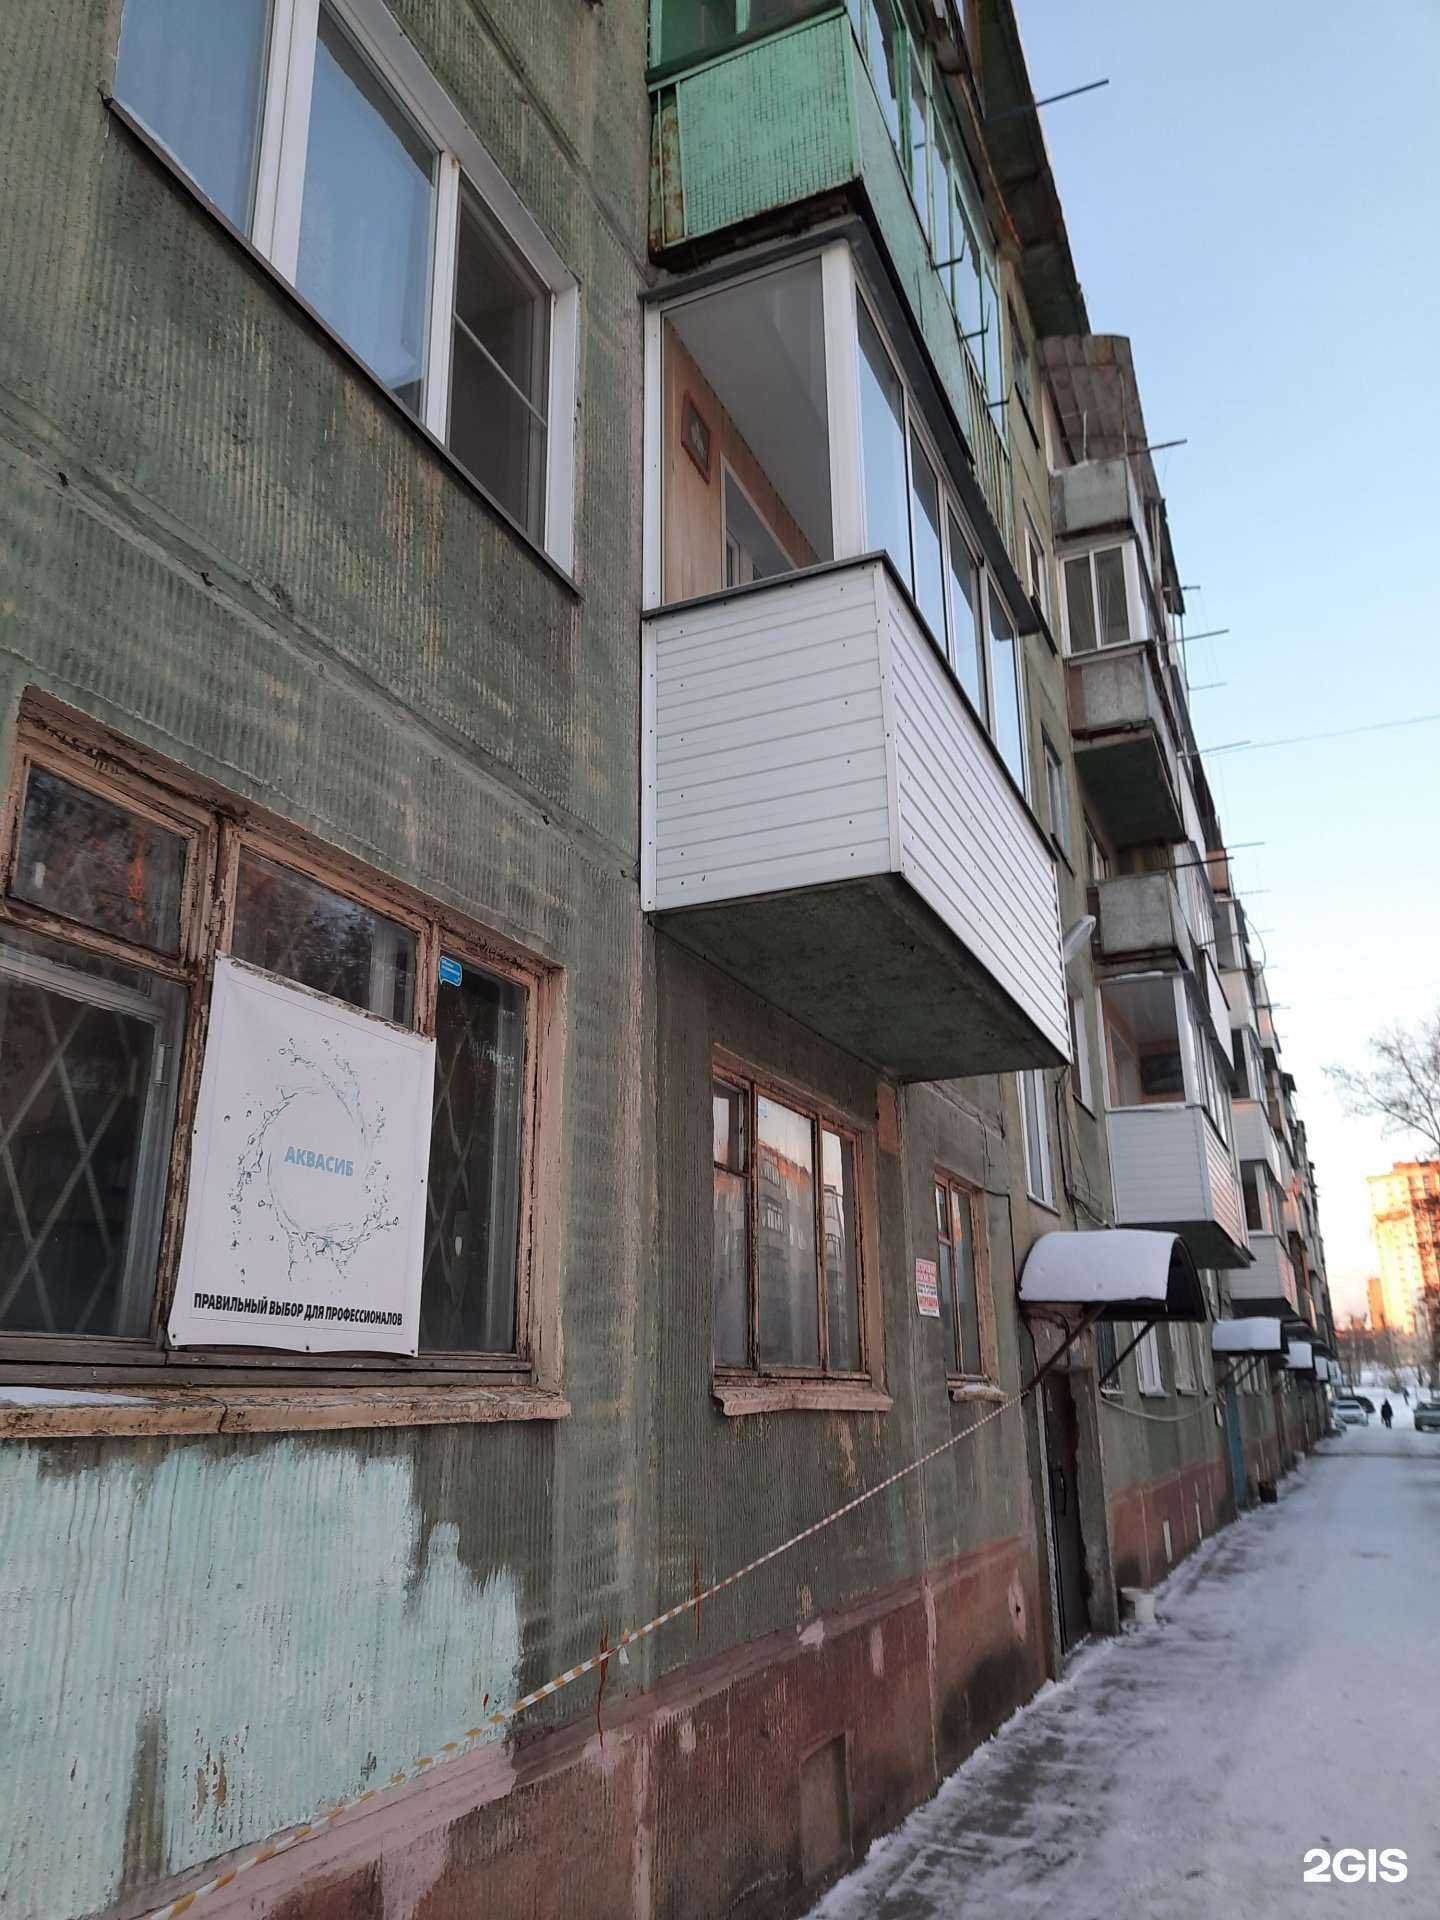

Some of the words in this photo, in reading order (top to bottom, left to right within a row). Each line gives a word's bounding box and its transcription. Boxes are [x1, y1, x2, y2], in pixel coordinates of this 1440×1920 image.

[284, 1146, 353, 1176] АКВАСИБ
[193, 1292, 268, 1314] ПРАВИЛЬНЫЙ
[268, 1300, 303, 1318] ВЫБОР
[303, 1304, 324, 1321] ДЛЯ
[325, 1306, 403, 1326] ПРОФЕССИОНАЛОВ
